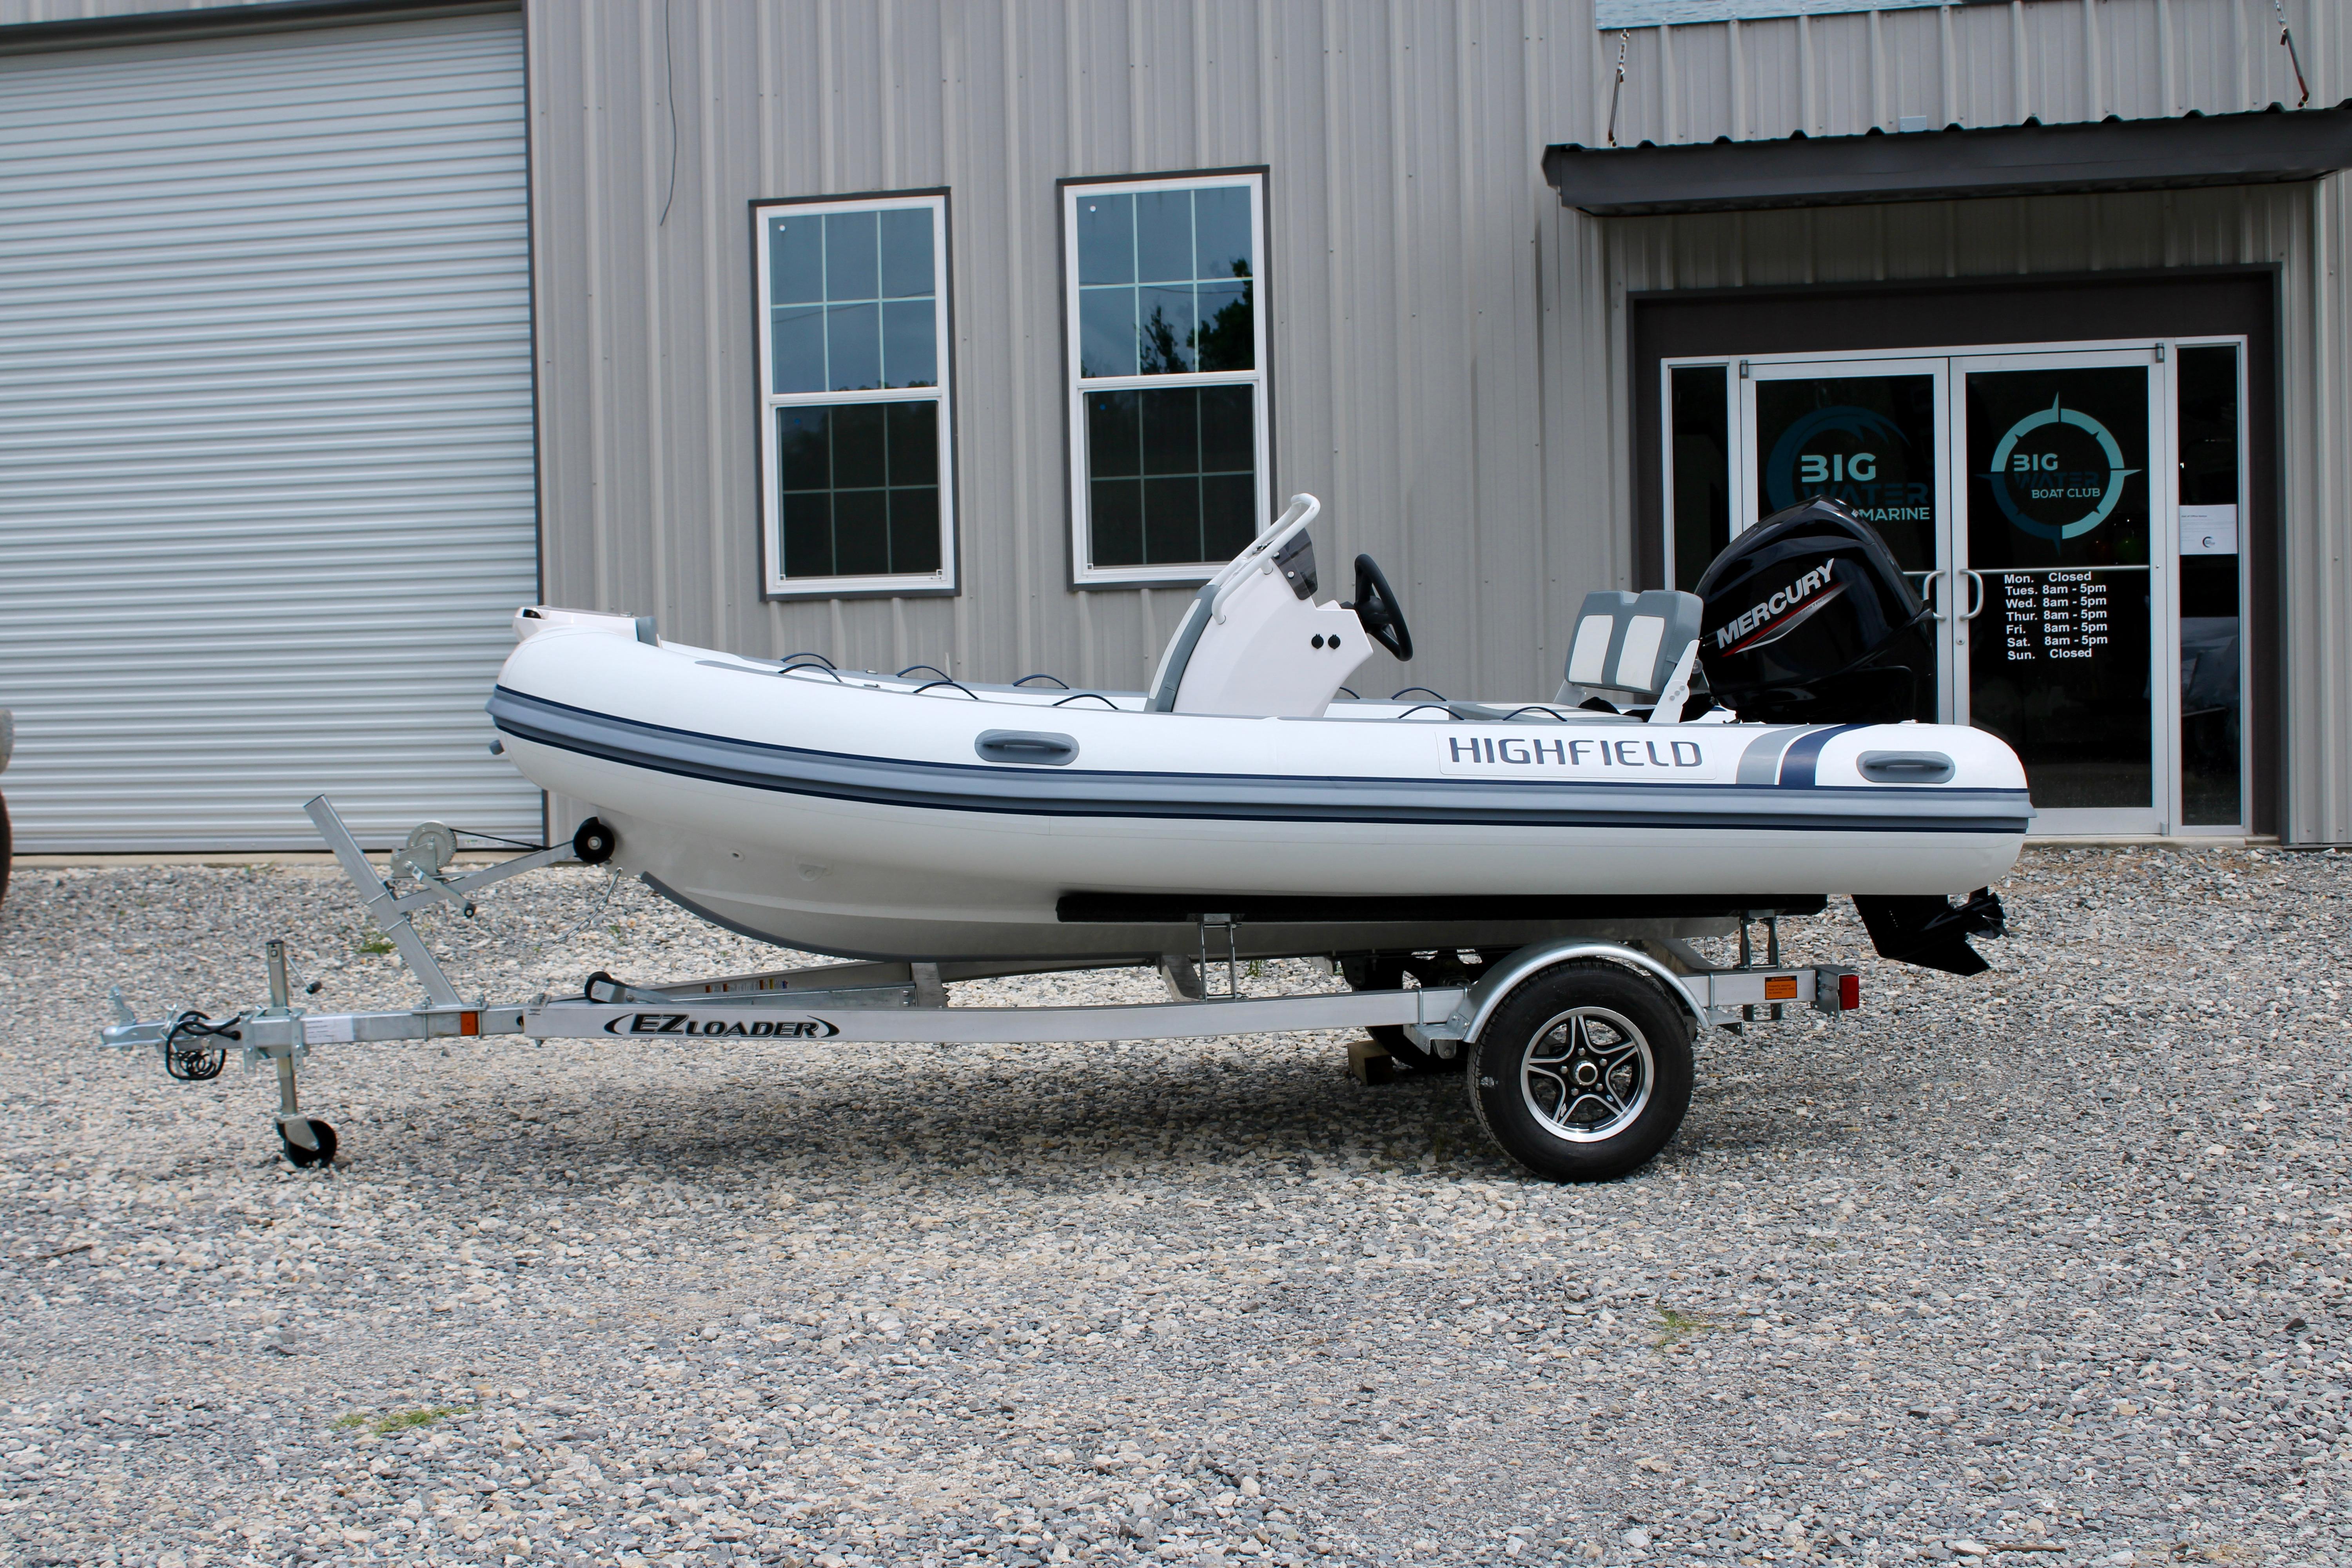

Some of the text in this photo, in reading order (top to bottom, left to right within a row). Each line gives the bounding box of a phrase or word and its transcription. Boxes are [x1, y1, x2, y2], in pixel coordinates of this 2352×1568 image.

[1801, 453, 1876, 483] BIG
[2013, 453, 2058, 472] BIG
[2013, 471, 2099, 489] WATER
[2031, 488, 2101, 499] BOAT CLUB
[1858, 507, 1930, 521] MARINE
[2004, 571, 2092, 584] Mon. Closed
[2005, 586, 2038, 595] Tues.
[2042, 585, 2068, 594] 8am
[2080, 583, 2106, 595] 5pm
[1717, 558, 1835, 649] MERCURY
[2005, 598, 2036, 608] Wed.
[2043, 598, 2069, 607] 8am
[2080, 596, 2107, 608] 5pm
[2006, 612, 2038, 621] Thur.
[2043, 610, 2069, 620] 8am
[2081, 609, 2107, 620] 5pm
[2006, 625, 2026, 634] Fri.
[2044, 623, 2069, 633] 8am
[2081, 622, 2107, 633] 5pm
[2007, 637, 2030, 647] Sat.
[2044, 636, 2070, 646] 8am
[2082, 635, 2108, 646] 5pm
[2007, 648, 2092, 660] Sun. Closed
[1449, 737, 1703, 767] HIGHFIELD
